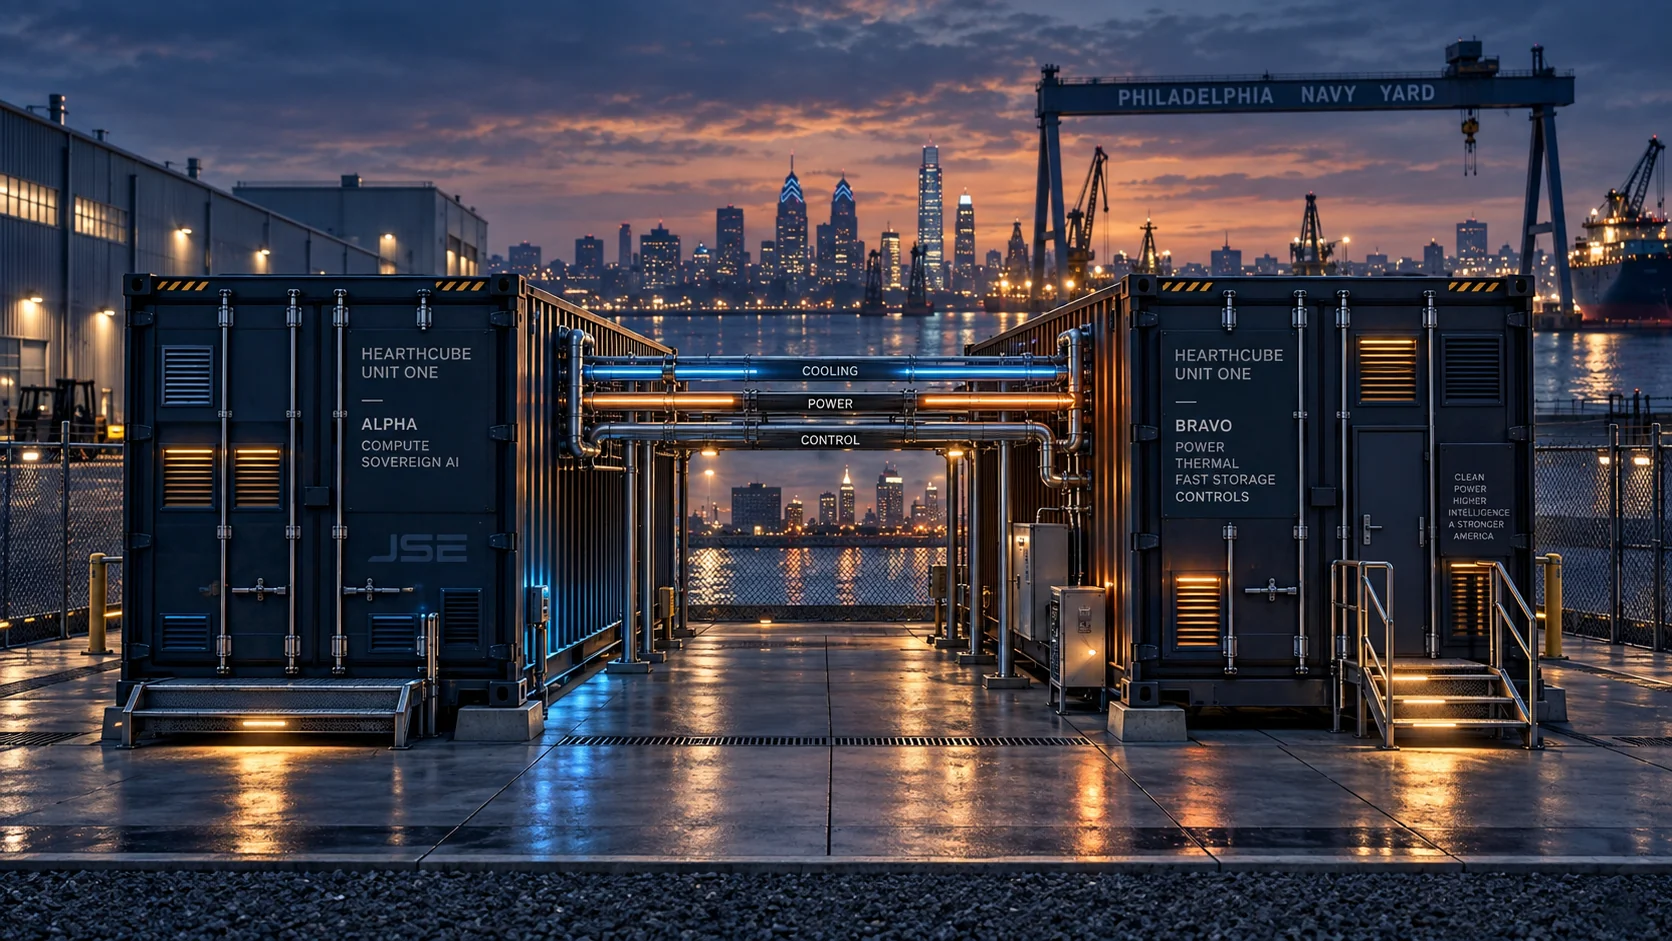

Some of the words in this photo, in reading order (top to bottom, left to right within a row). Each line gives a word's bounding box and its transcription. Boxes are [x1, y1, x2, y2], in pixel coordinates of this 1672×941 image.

[1118, 87, 1274, 106] PHILADELPHIA
[1301, 85, 1357, 103] NAVY
[1379, 84, 1435, 102] YARD
[361, 347, 472, 361] HEARTHCUBE
[1174, 348, 1284, 362] HEARTHCUBE
[361, 365, 400, 379] UNIT
[404, 365, 439, 379] ONE
[802, 365, 859, 377] COOLING
[1174, 367, 1213, 381] UNIT
[1217, 367, 1252, 381] ONE
[807, 398, 853, 410] POWER
[361, 417, 418, 431] ALPHA
[1175, 418, 1233, 432] BRAVO
[361, 439, 430, 452] COMPUTE
[800, 434, 861, 447] CONTROL
[1175, 441, 1225, 453] POWER
[361, 456, 441, 468] SOVEREIGN
[445, 456, 459, 468] AI
[1175, 457, 1240, 469] THERMAL
[1175, 473, 1209, 486] FAST
[1212, 473, 1276, 486] STORAGE
[1454, 473, 1485, 482] CLEAN
[1454, 485, 1487, 493] POWER
[1175, 491, 1250, 503] CONTROLS
[1453, 497, 1487, 505] HIGHER
[1448, 520, 1455, 529] A
[1457, 520, 1505, 529] STRONGER
[1453, 532, 1494, 540] AMERICA
[367, 533, 468, 563] JSE
